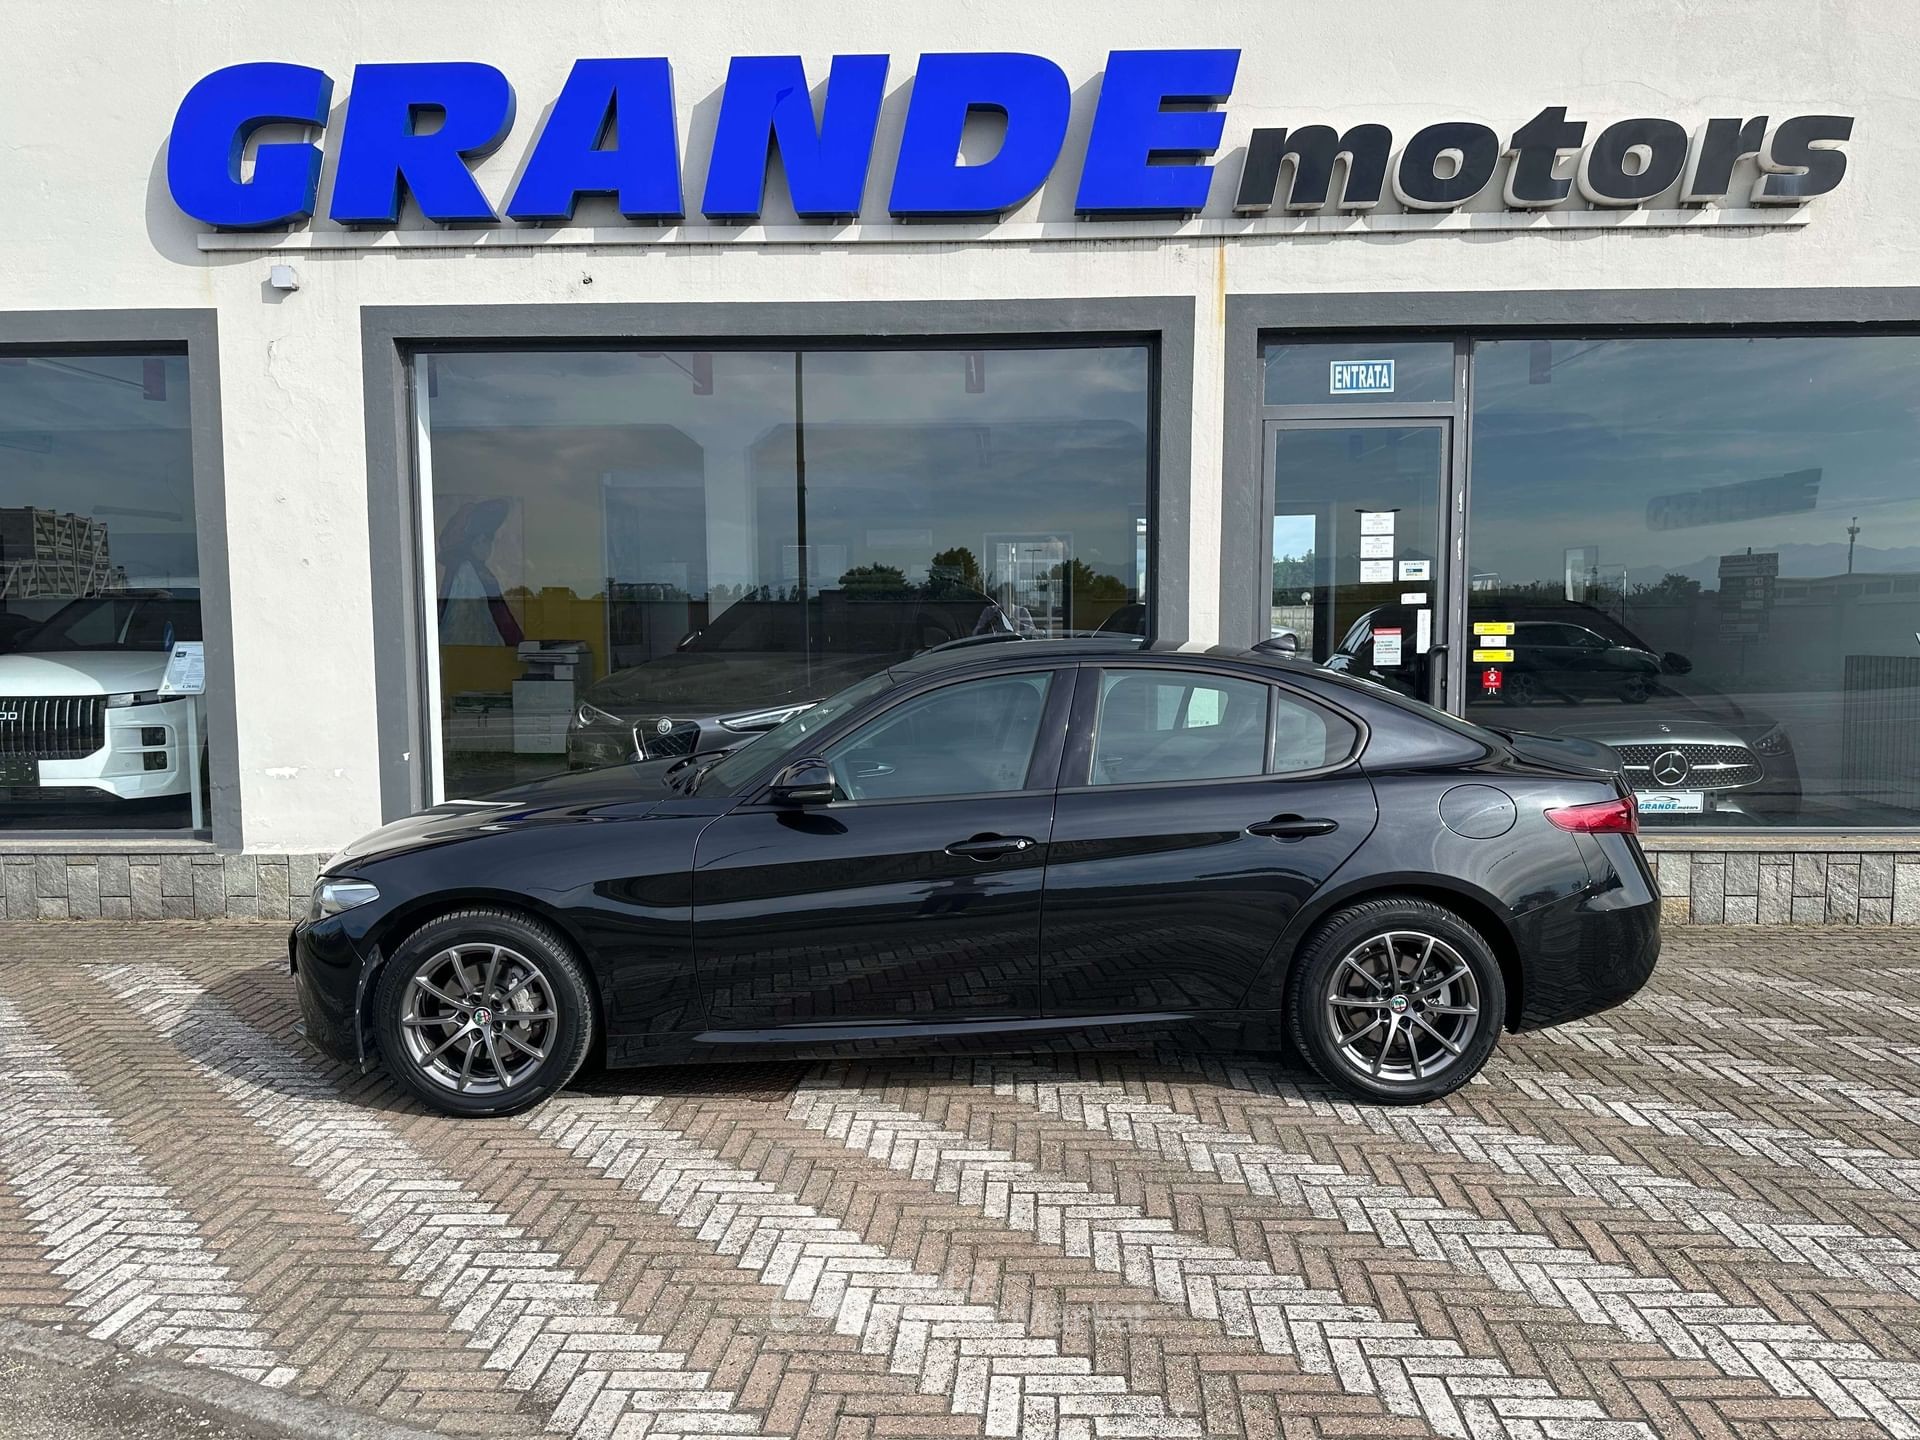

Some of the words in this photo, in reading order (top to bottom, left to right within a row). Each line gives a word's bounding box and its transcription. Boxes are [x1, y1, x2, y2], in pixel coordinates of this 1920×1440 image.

[166, 48, 1241, 230] GRANDE
[1232, 106, 1855, 212] motors
[1335, 365, 1389, 388] ENTRATA
